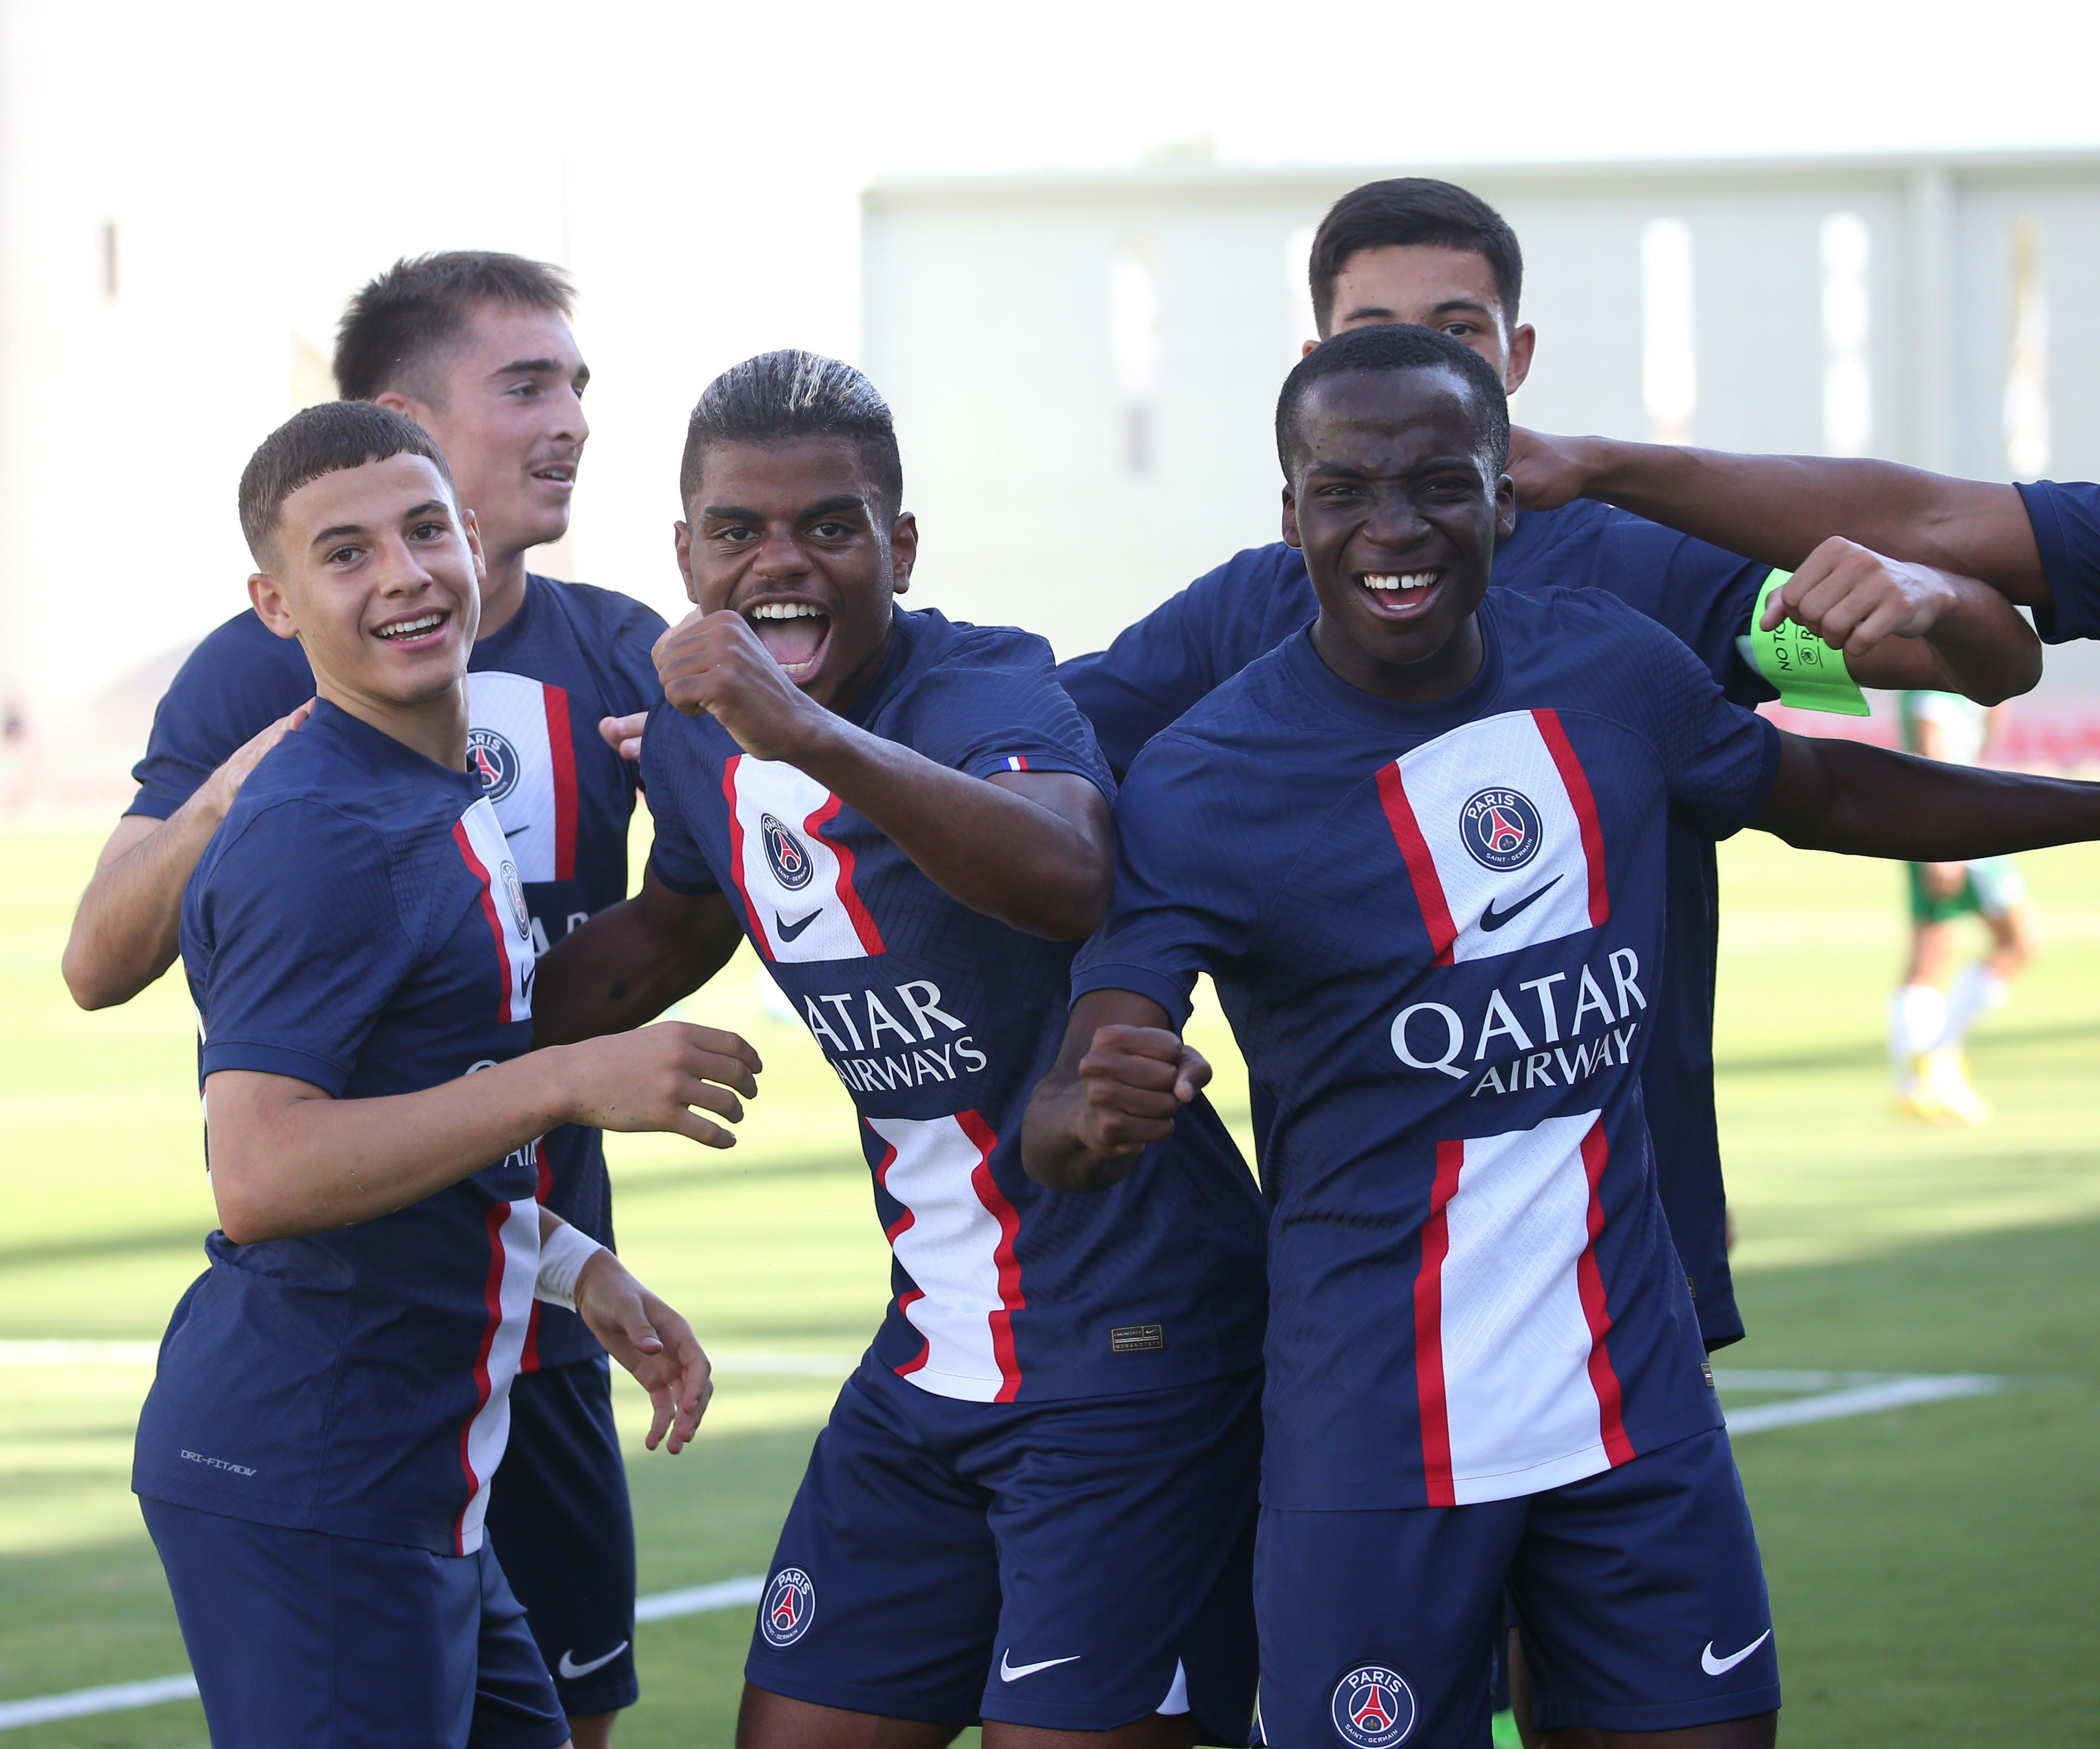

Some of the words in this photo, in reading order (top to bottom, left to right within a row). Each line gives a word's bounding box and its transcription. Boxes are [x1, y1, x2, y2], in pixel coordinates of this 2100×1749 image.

[1776, 647, 1793, 671] NO
[467, 734, 502, 751] ARIS
[1467, 793, 1515, 820] PARIS
[765, 818, 789, 835] PARIS
[803, 980, 967, 1052] ATAR
[1390, 947, 1647, 1080] QATAR
[831, 1036, 987, 1091] AIRWAYS
[1470, 1023, 1641, 1097] AIRWAY
[778, 1572, 810, 1595] PARIS
[1348, 1670, 1402, 1693] PARIS
